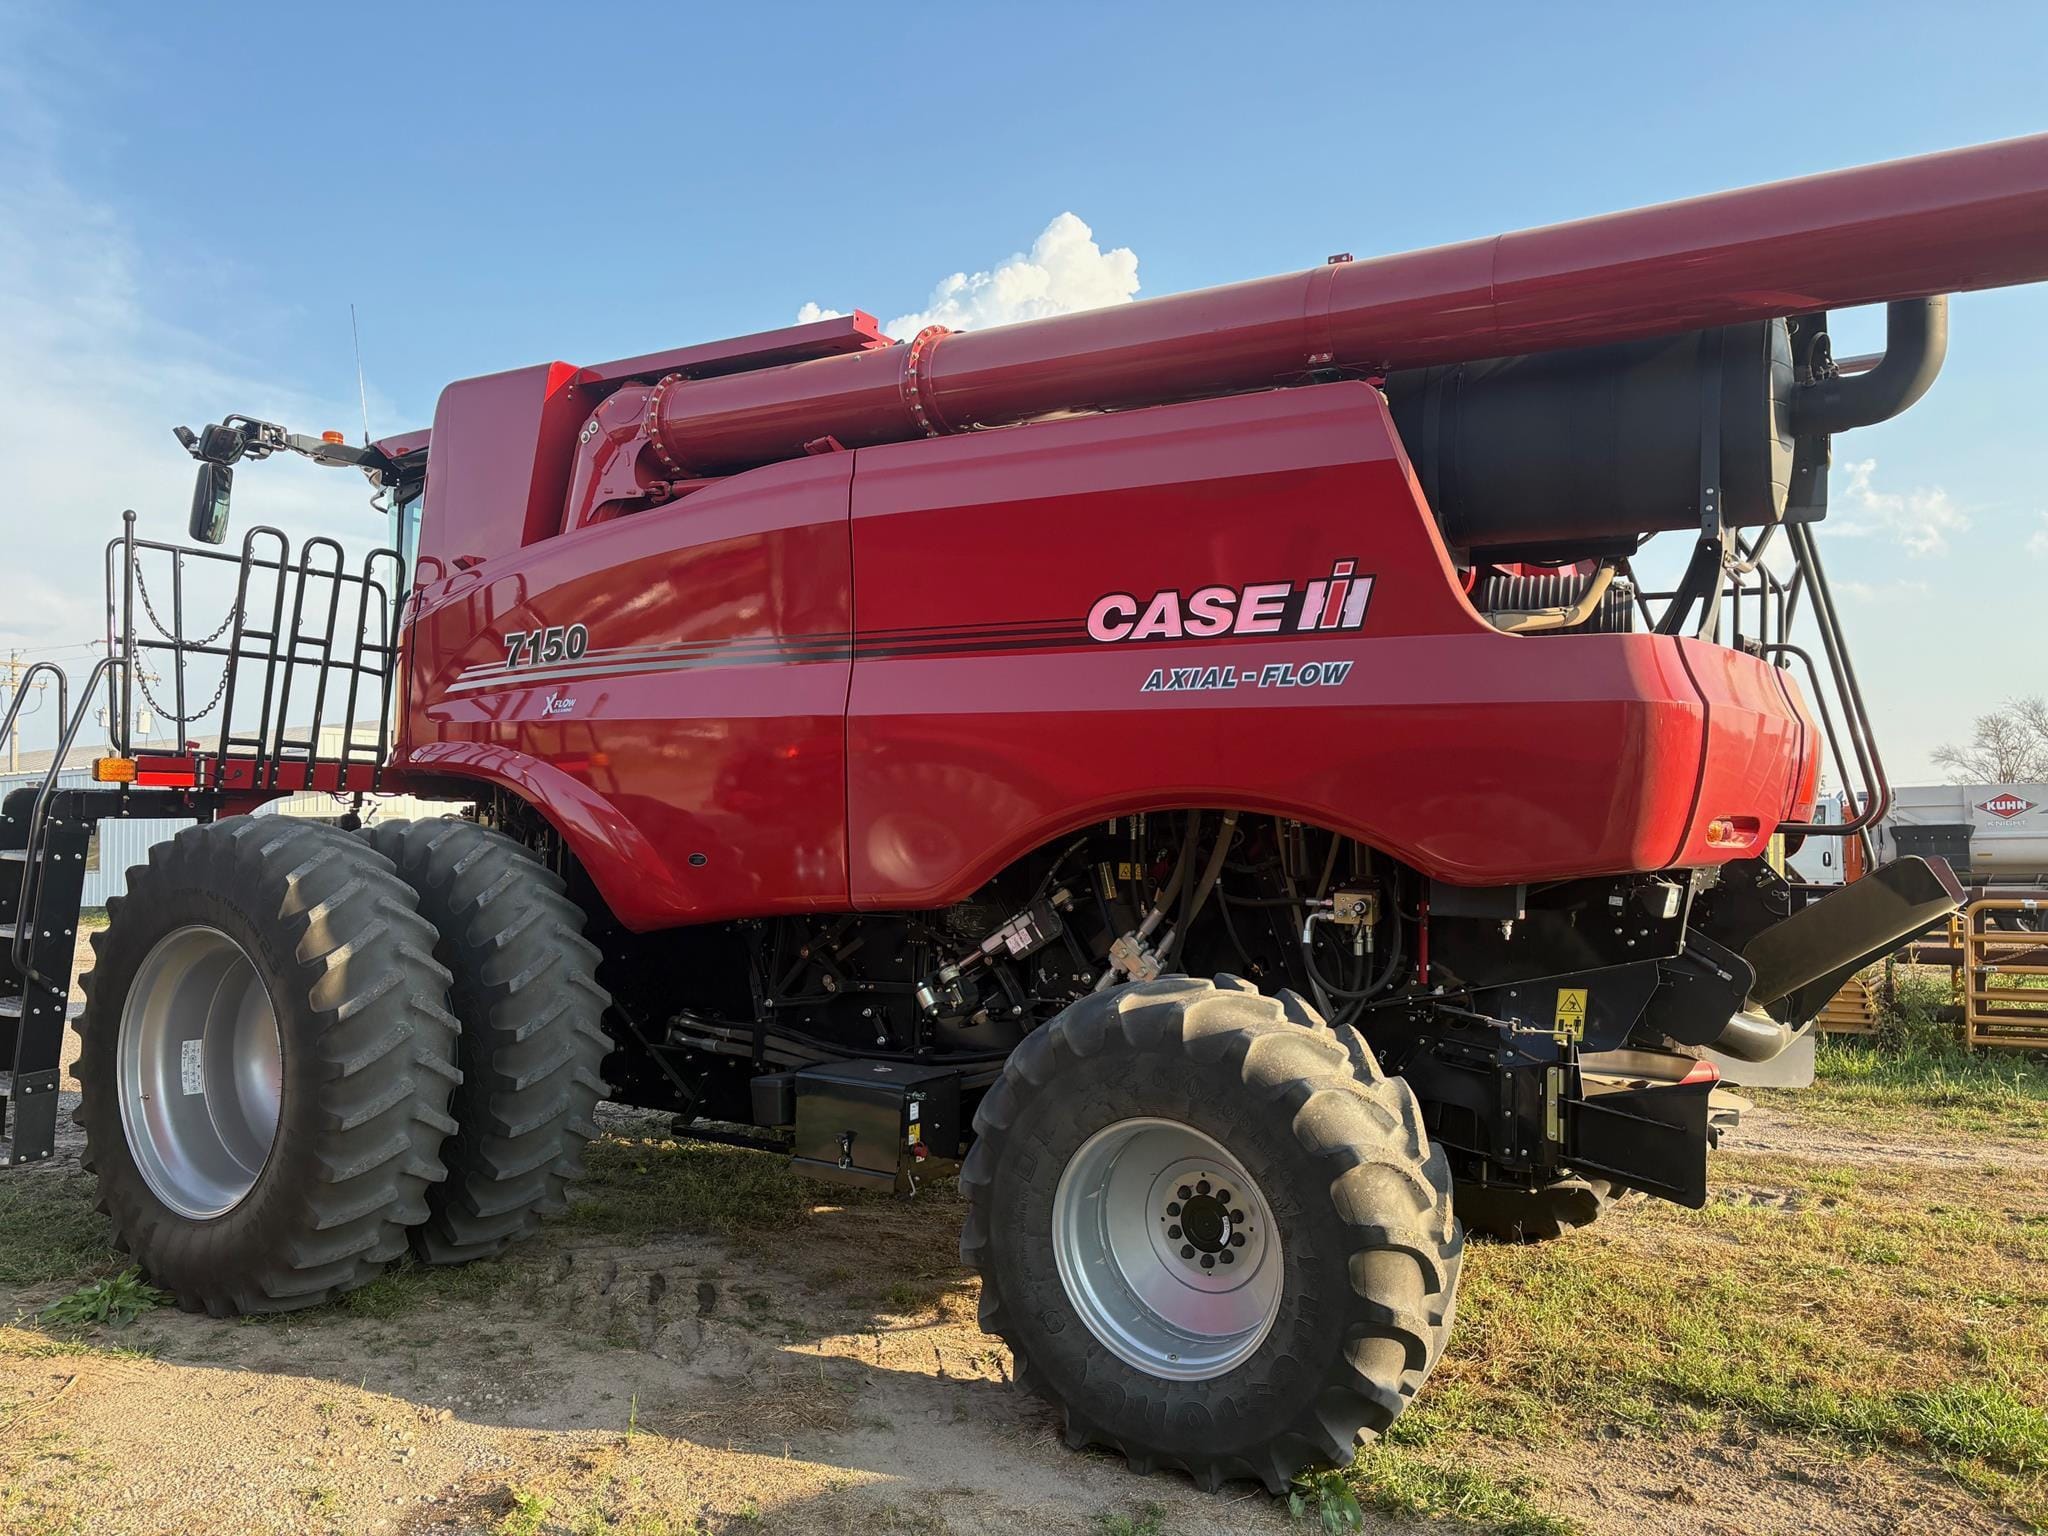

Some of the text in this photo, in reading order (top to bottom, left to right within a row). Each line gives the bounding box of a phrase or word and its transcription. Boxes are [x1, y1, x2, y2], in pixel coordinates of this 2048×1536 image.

[1086, 582, 1292, 643] CASE
[504, 623, 588, 670] 7150
[554, 697, 577, 708] FLOW
[1987, 800, 2027, 810] KUHN
